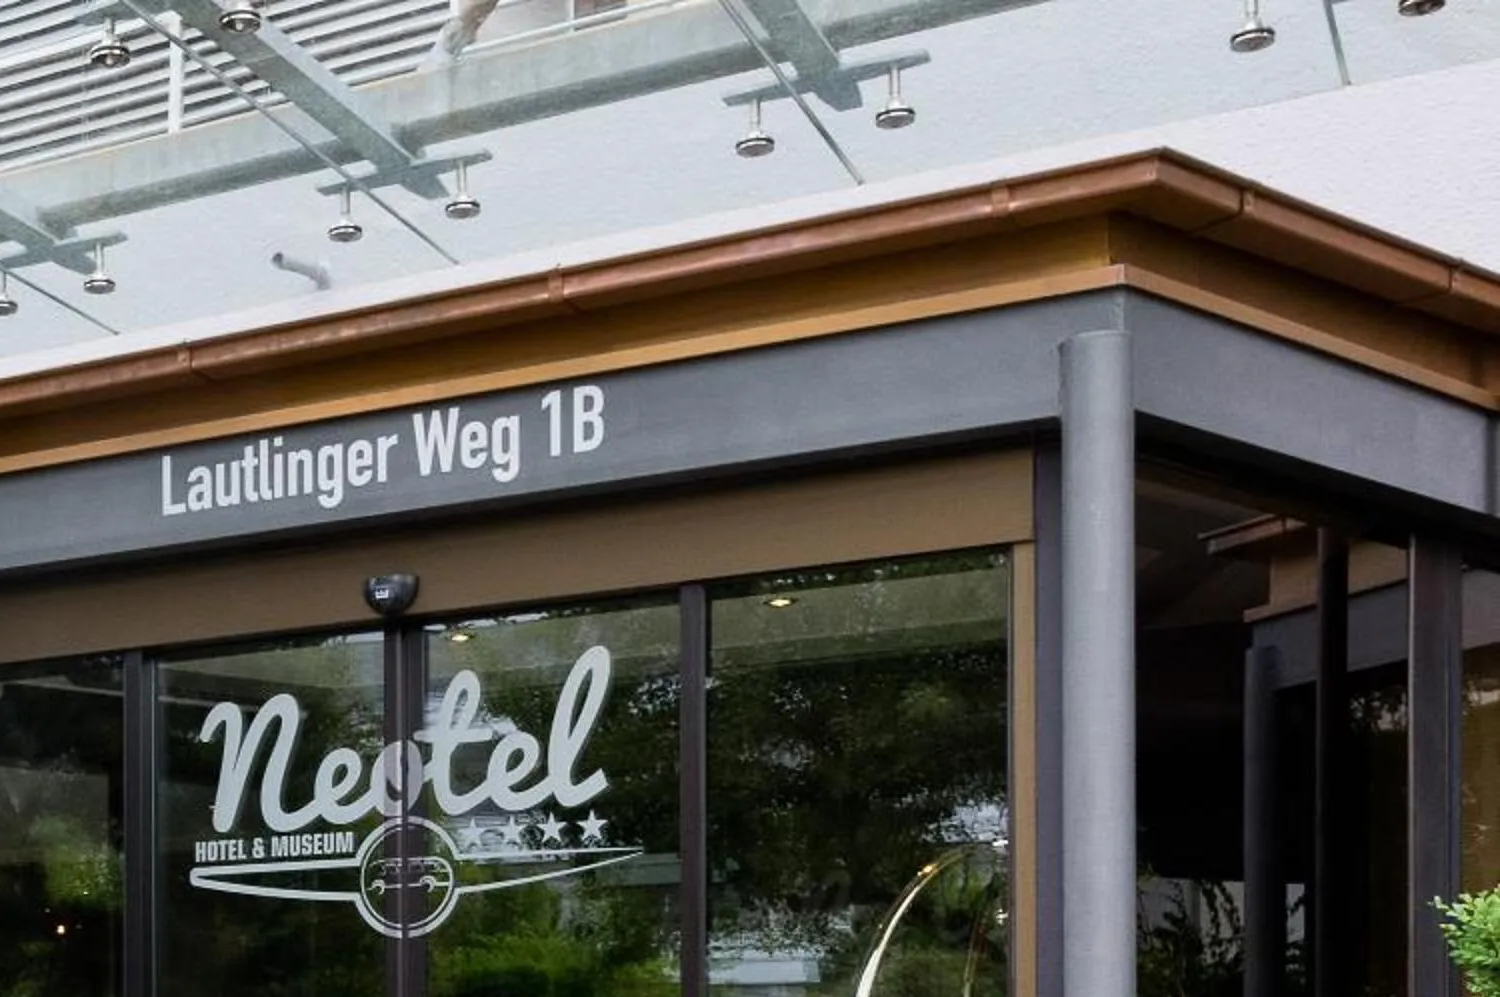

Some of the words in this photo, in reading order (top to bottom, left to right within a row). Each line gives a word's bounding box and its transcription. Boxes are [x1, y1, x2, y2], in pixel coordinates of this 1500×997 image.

[160, 434, 399, 516] Lautlinger
[412, 406, 521, 483] Weg
[540, 384, 606, 456] 1B
[195, 838, 248, 863] HOTEL
[252, 836, 266, 860] &
[271, 830, 355, 858] MUSEUM
